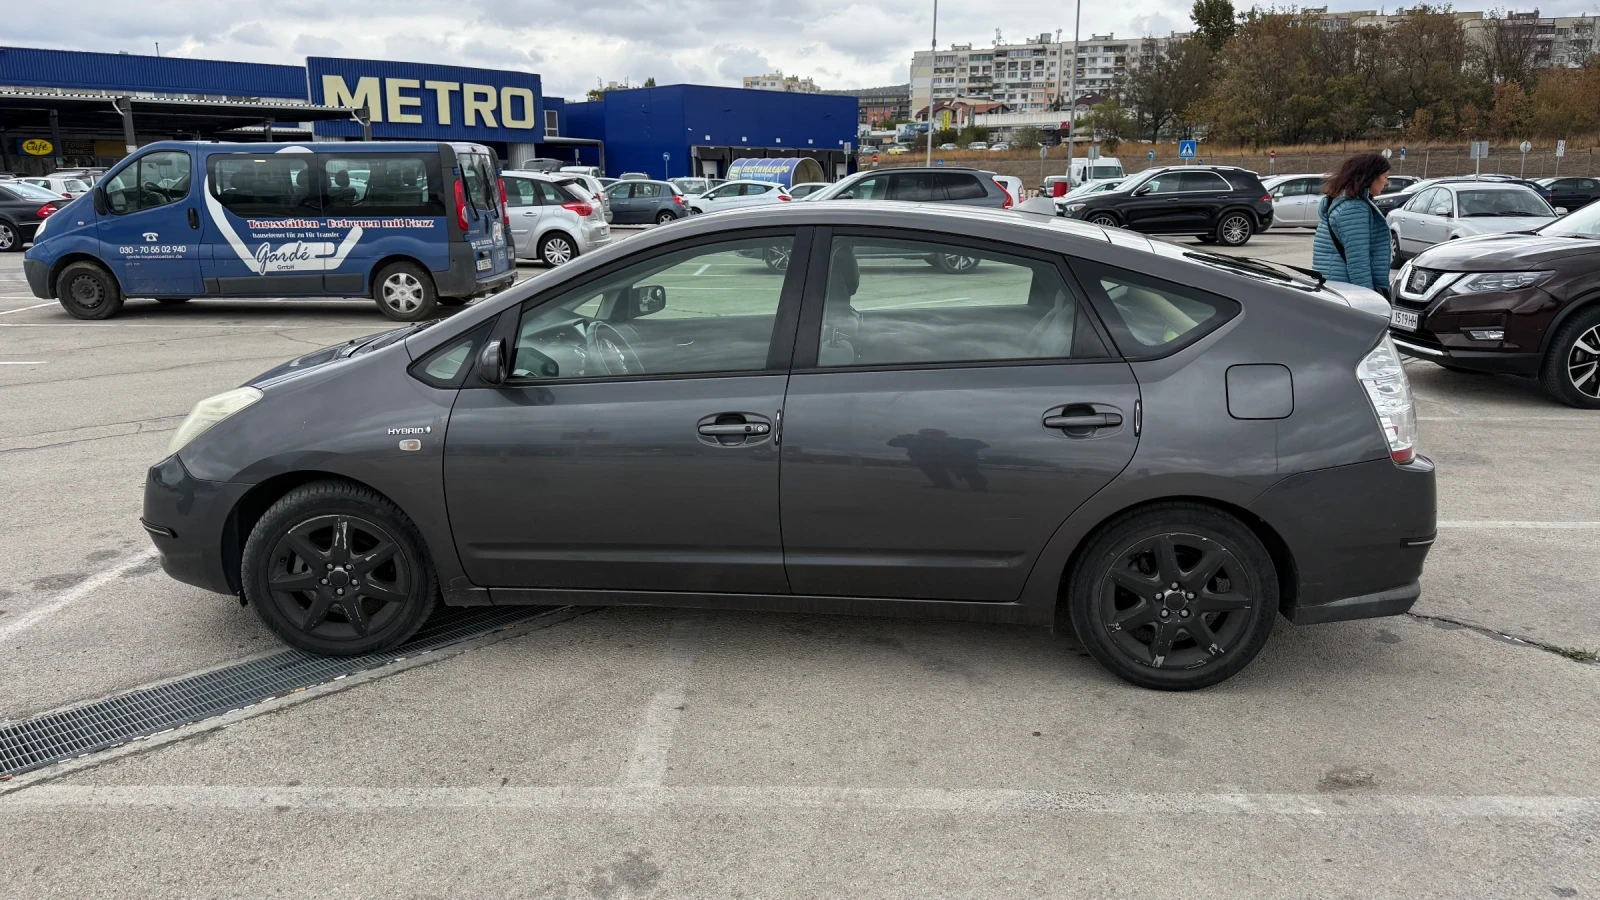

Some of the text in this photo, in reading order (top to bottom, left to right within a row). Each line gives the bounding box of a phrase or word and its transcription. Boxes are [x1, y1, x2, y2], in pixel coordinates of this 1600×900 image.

[322, 74, 535, 130] METRO
[382, 218, 404, 228] mit
[405, 219, 434, 228] Herz
[119, 246, 133, 254] 030
[161, 245, 171, 253] 02
[172, 245, 186, 253] 940
[388, 427, 424, 435] HYBRID
